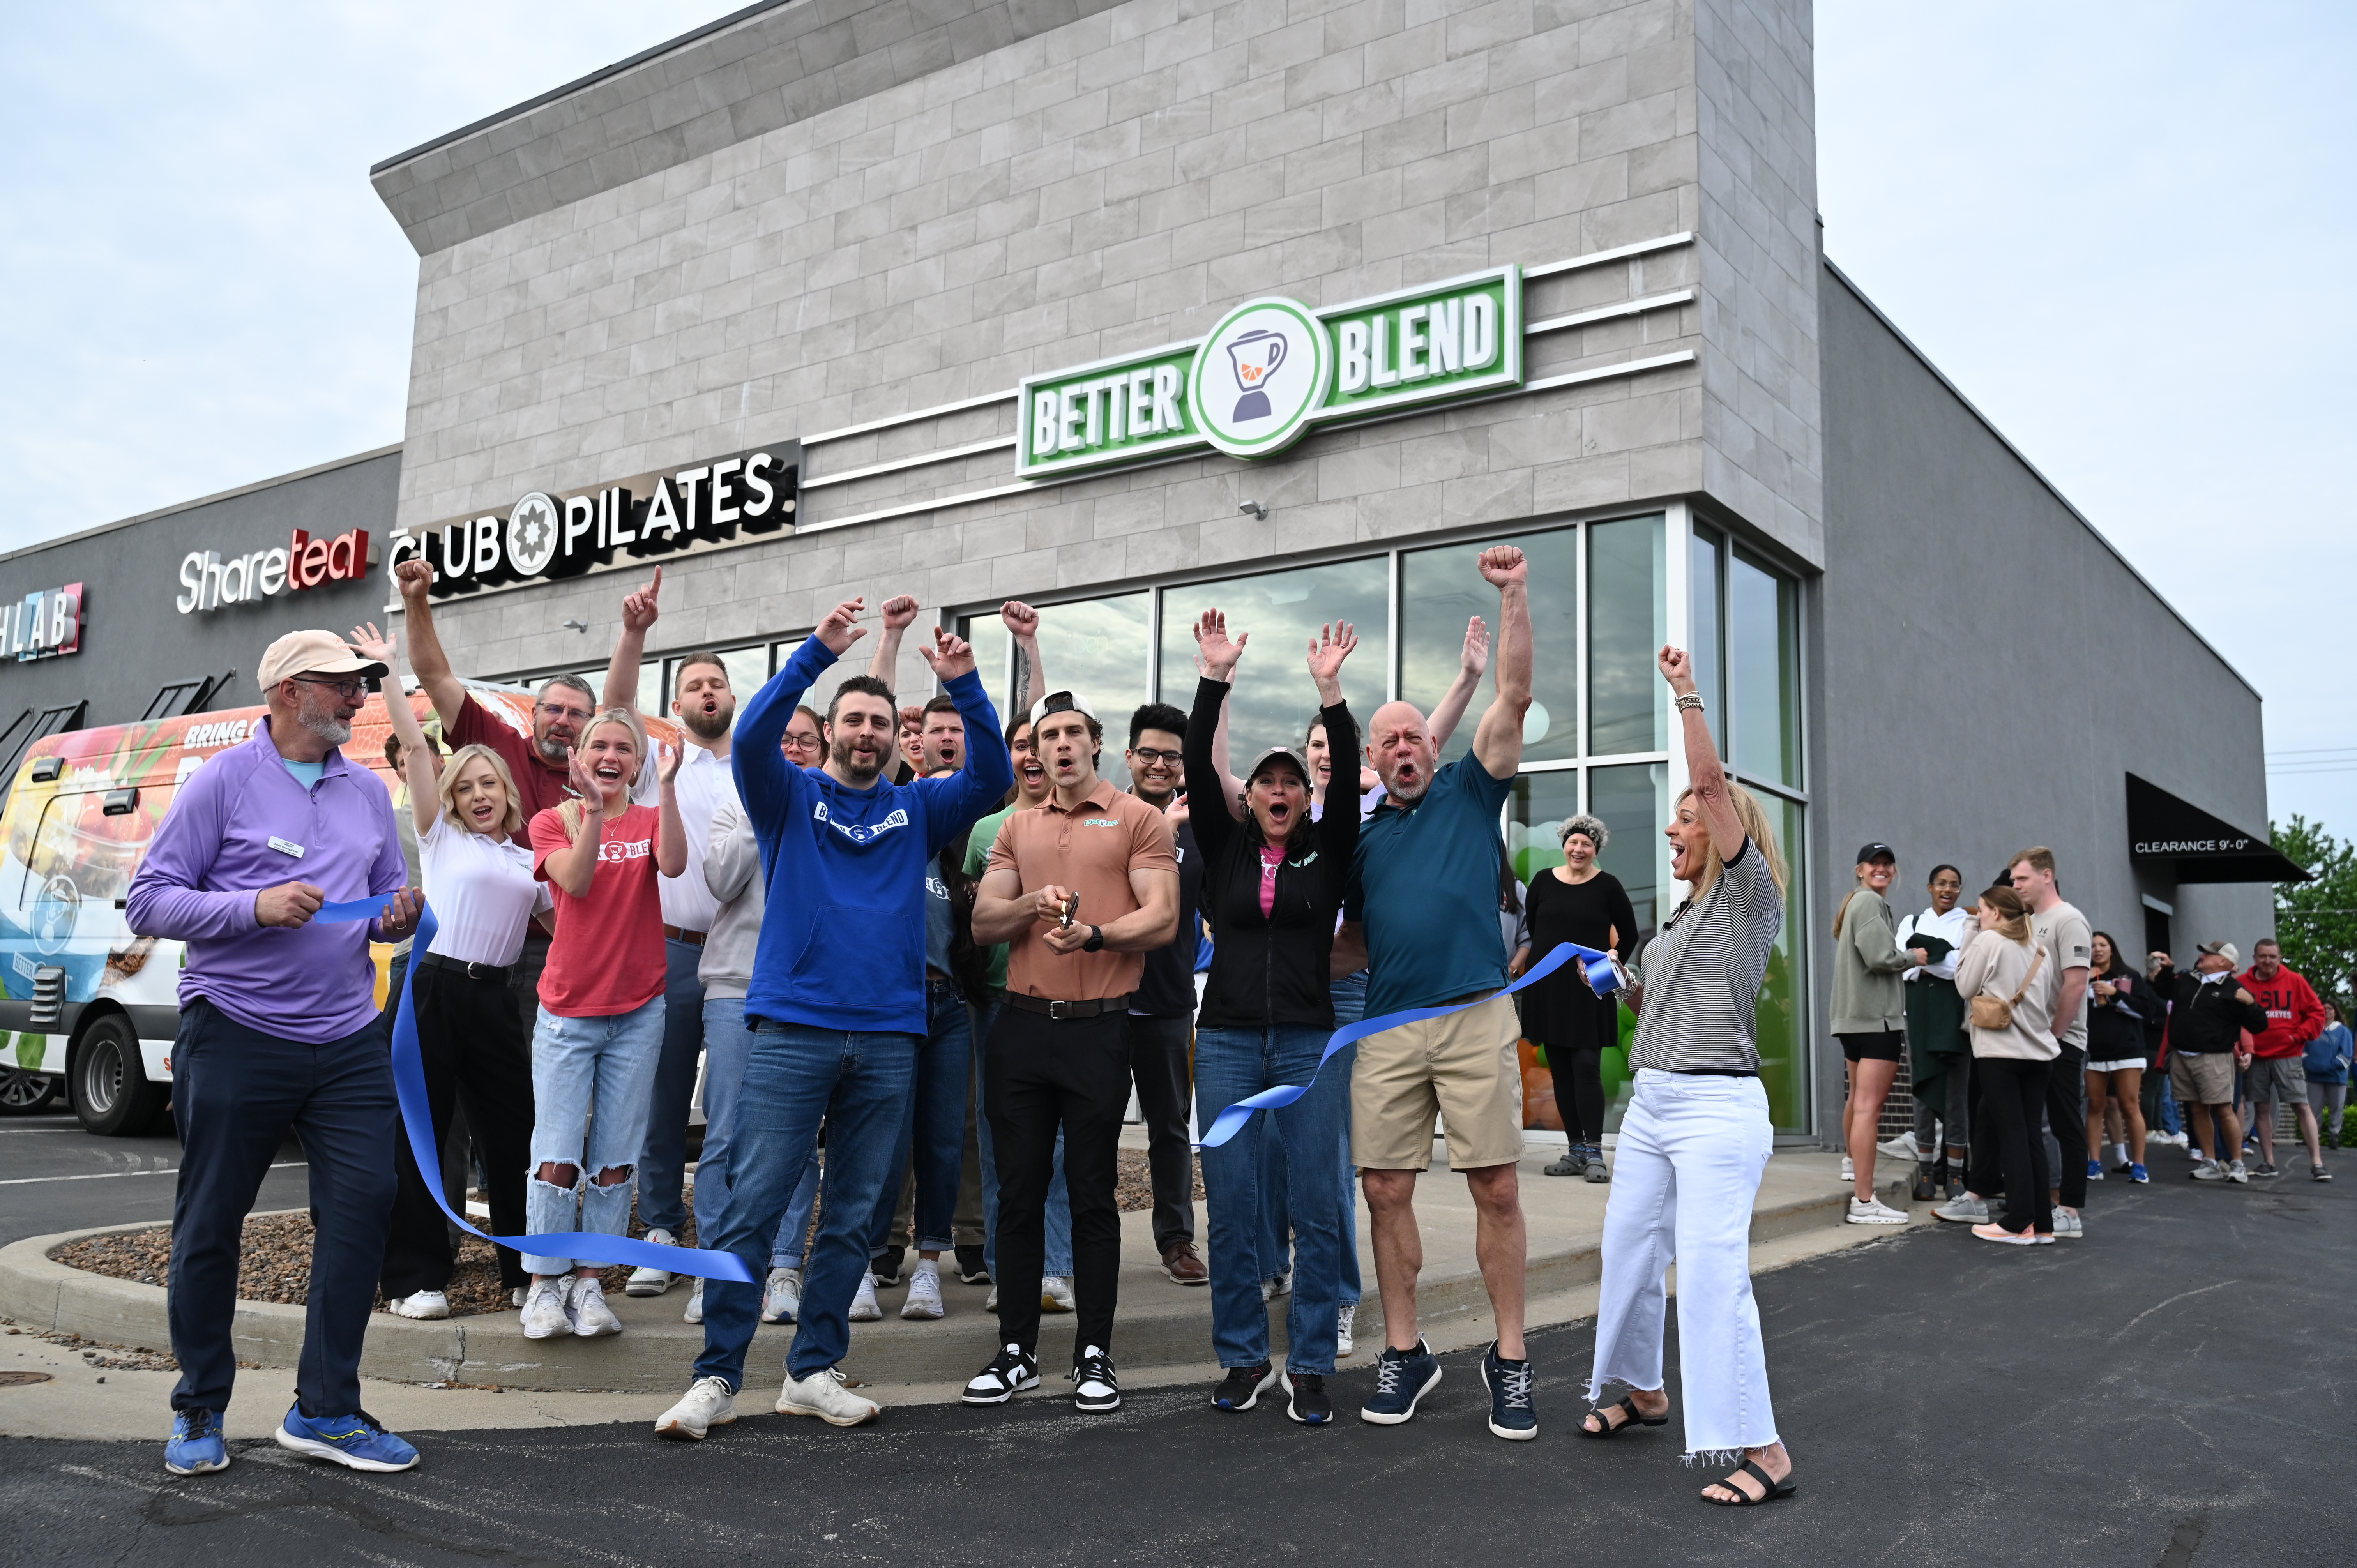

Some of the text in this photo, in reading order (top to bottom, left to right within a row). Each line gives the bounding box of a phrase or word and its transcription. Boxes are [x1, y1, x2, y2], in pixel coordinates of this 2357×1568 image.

[1033, 293, 1498, 456] BETTER BLEND
[389, 452, 774, 589] CLUB PILATES
[184, 719, 247, 749] BRING
[876, 812, 905, 833] BLEND
[630, 841, 651, 856] BLE
[2135, 840, 2216, 853] CLEARANCE
[15, 955, 33, 978] BETTER
[2253, 991, 2292, 1010] SU
[2265, 1010, 2292, 1019] CKEYES
